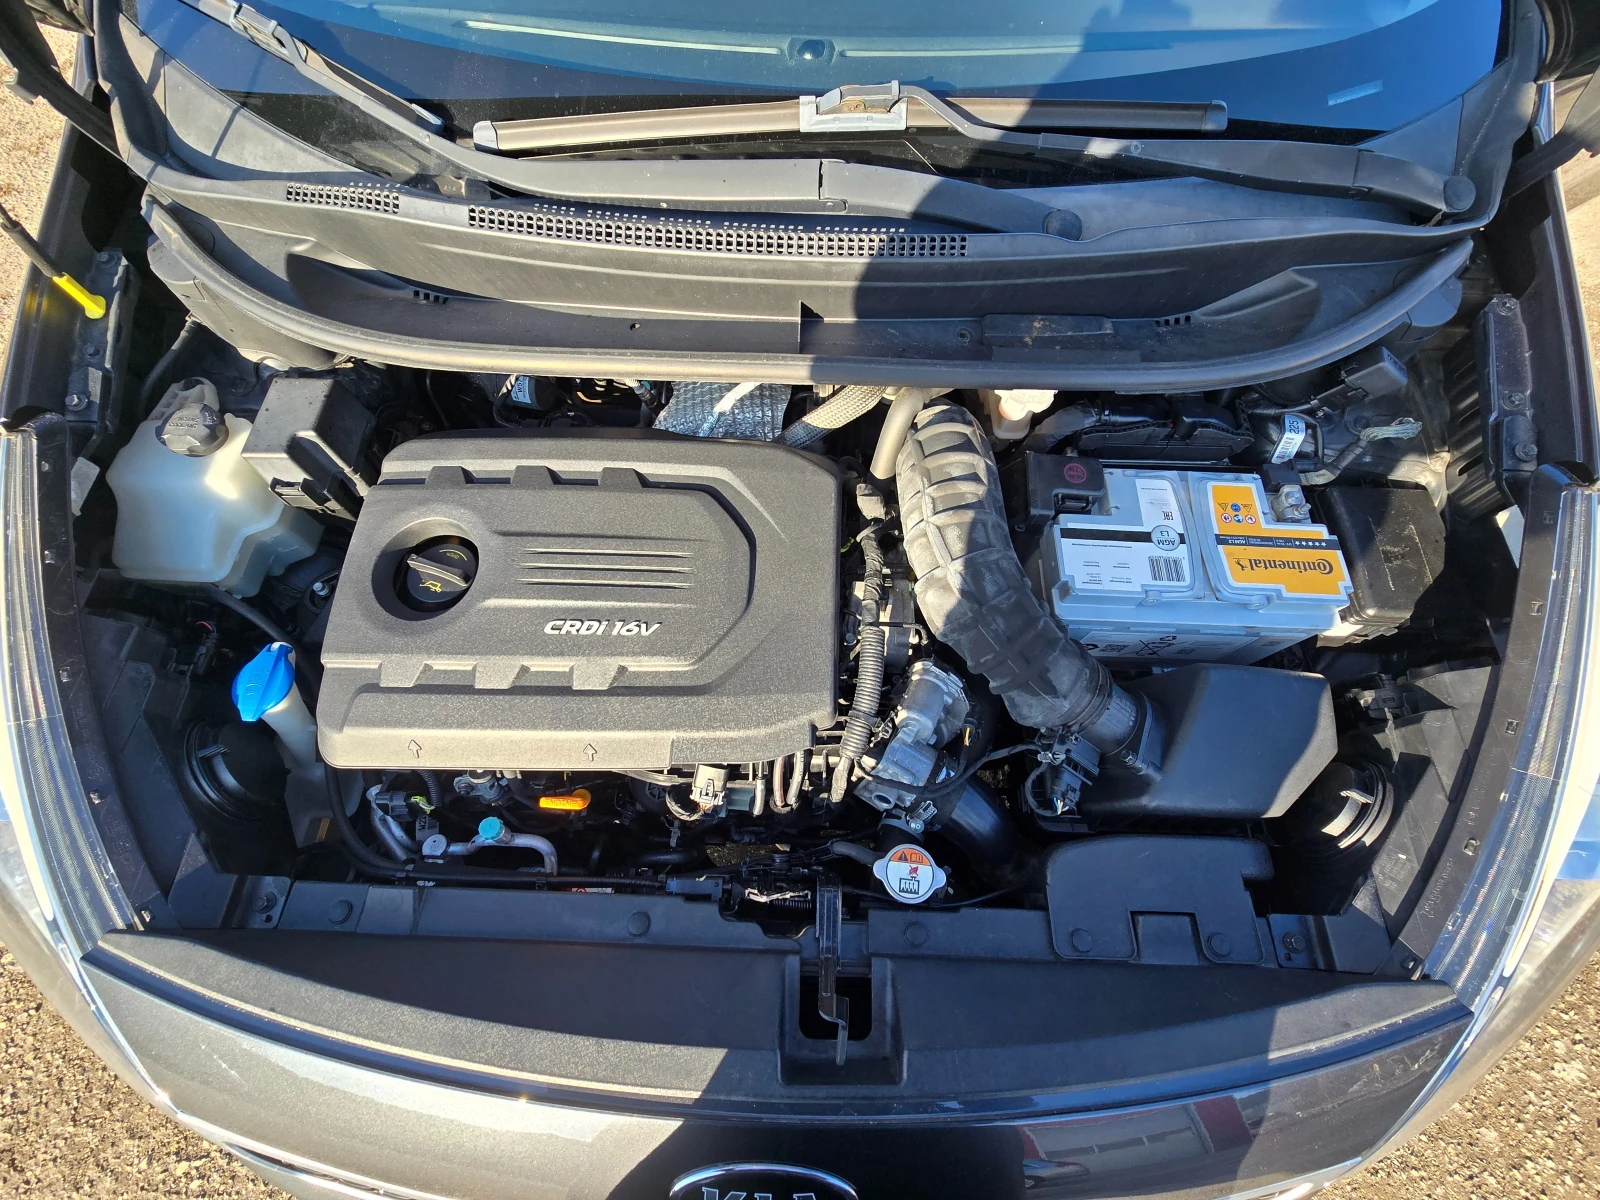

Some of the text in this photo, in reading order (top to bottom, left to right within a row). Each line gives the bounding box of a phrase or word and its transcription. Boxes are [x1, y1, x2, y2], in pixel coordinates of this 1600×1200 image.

[1288, 419, 1300, 435] 225
[1156, 538, 1176, 547] AGM
[1248, 558, 1334, 575] Continental
[612, 620, 662, 637] 16V
[544, 799, 578, 808] ENGINE
